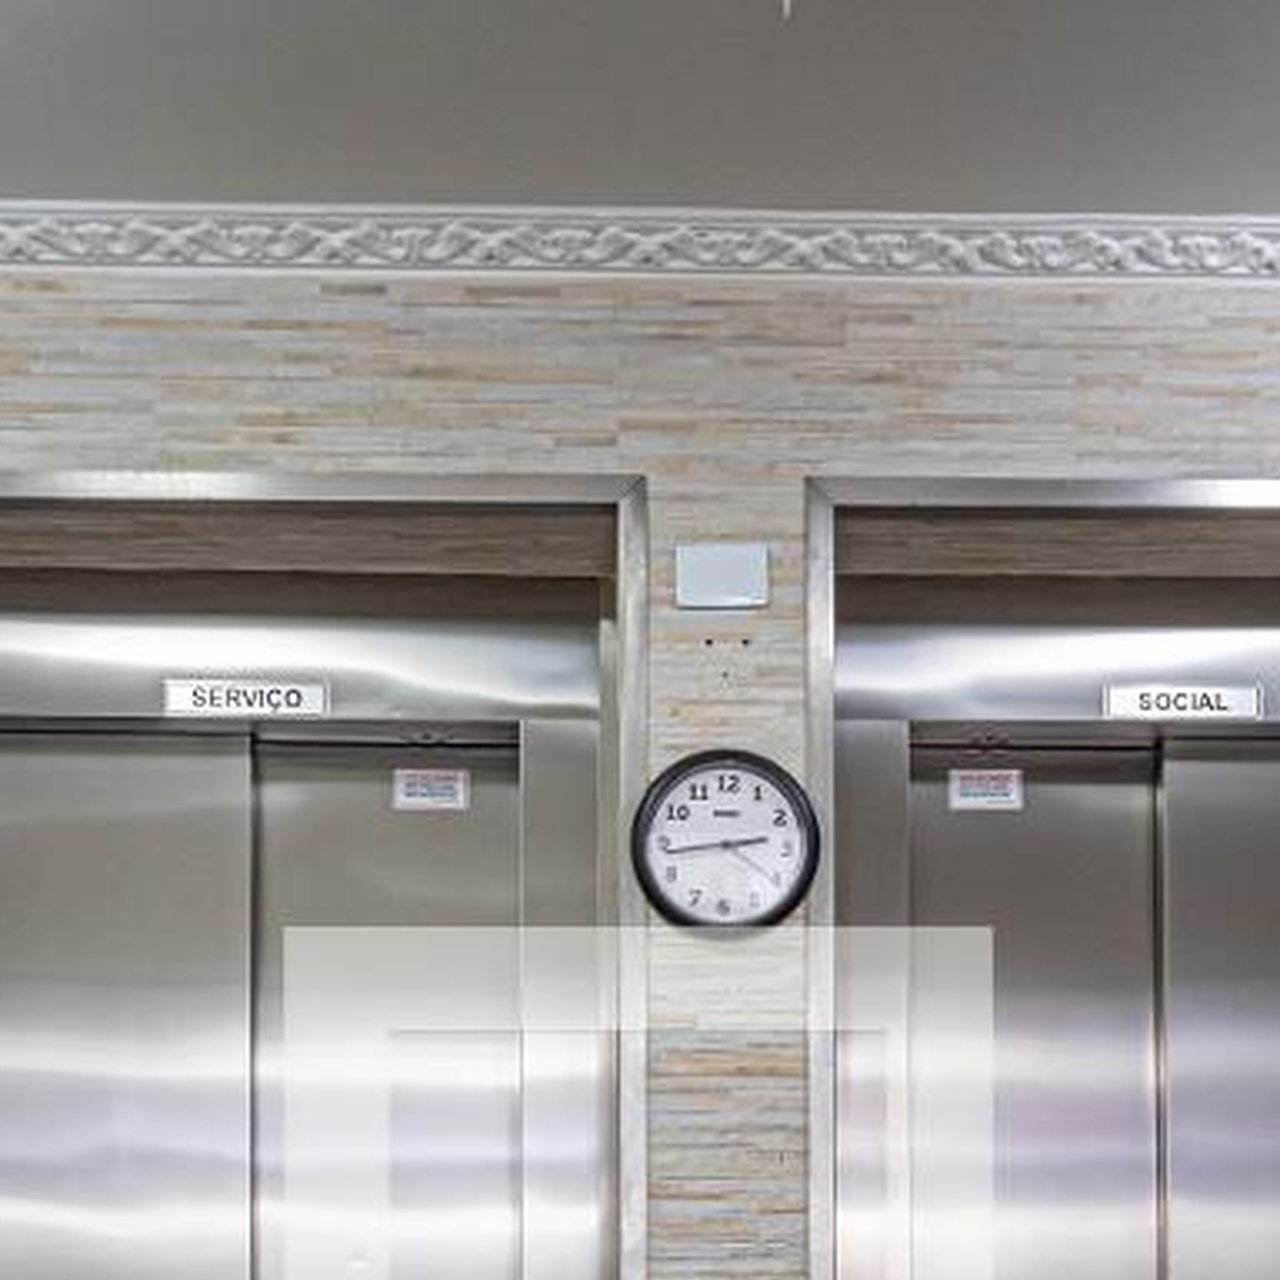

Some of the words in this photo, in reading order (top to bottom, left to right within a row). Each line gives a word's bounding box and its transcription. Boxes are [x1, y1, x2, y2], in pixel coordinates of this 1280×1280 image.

[192, 686, 303, 711] SERVIÇO
[1139, 692, 1229, 711] SOCIAL
[718, 775, 740, 793] 12
[690, 785, 708, 801] 11
[754, 786, 762, 801] 1
[666, 806, 690, 821] 10
[773, 810, 787, 827] 2
[689, 890, 702, 907] 7
